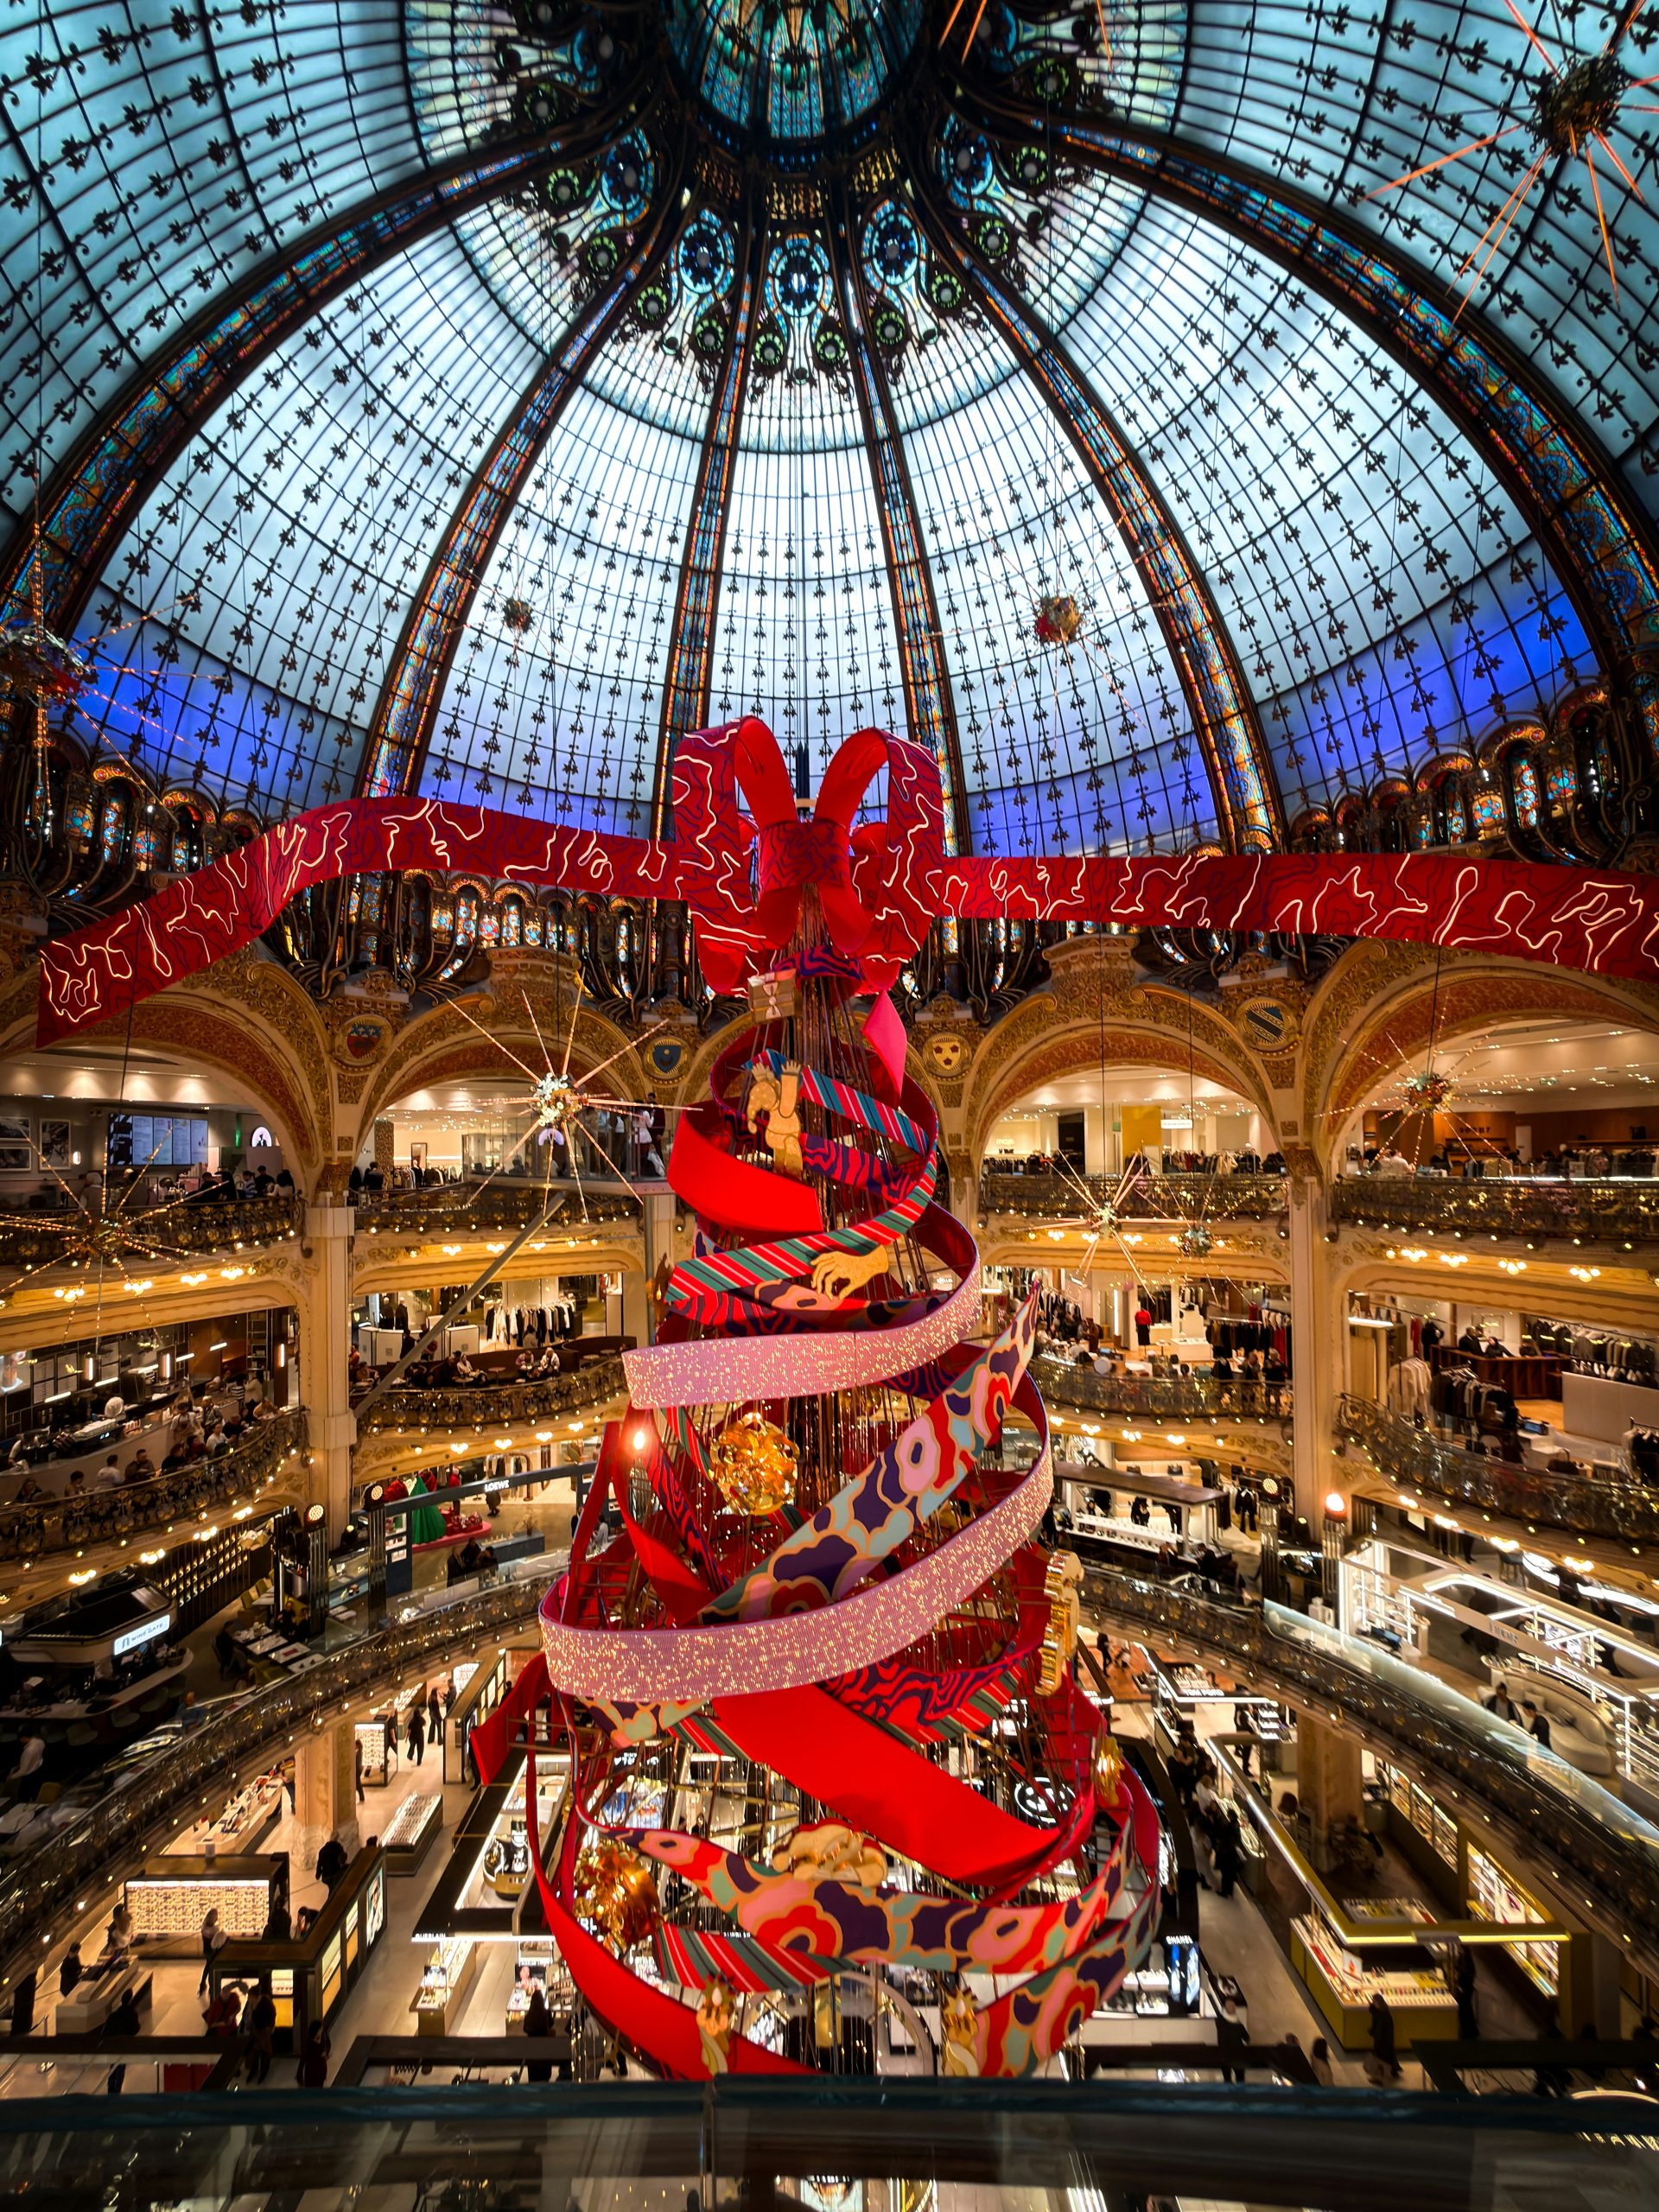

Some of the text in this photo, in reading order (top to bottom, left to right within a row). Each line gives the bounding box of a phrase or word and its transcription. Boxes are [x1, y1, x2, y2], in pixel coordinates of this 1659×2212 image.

[485, 1479, 510, 1492] LOEWE
[1181, 1688, 1225, 1697] TOM FORD
[1166, 1935, 1193, 1945] CHANEL
